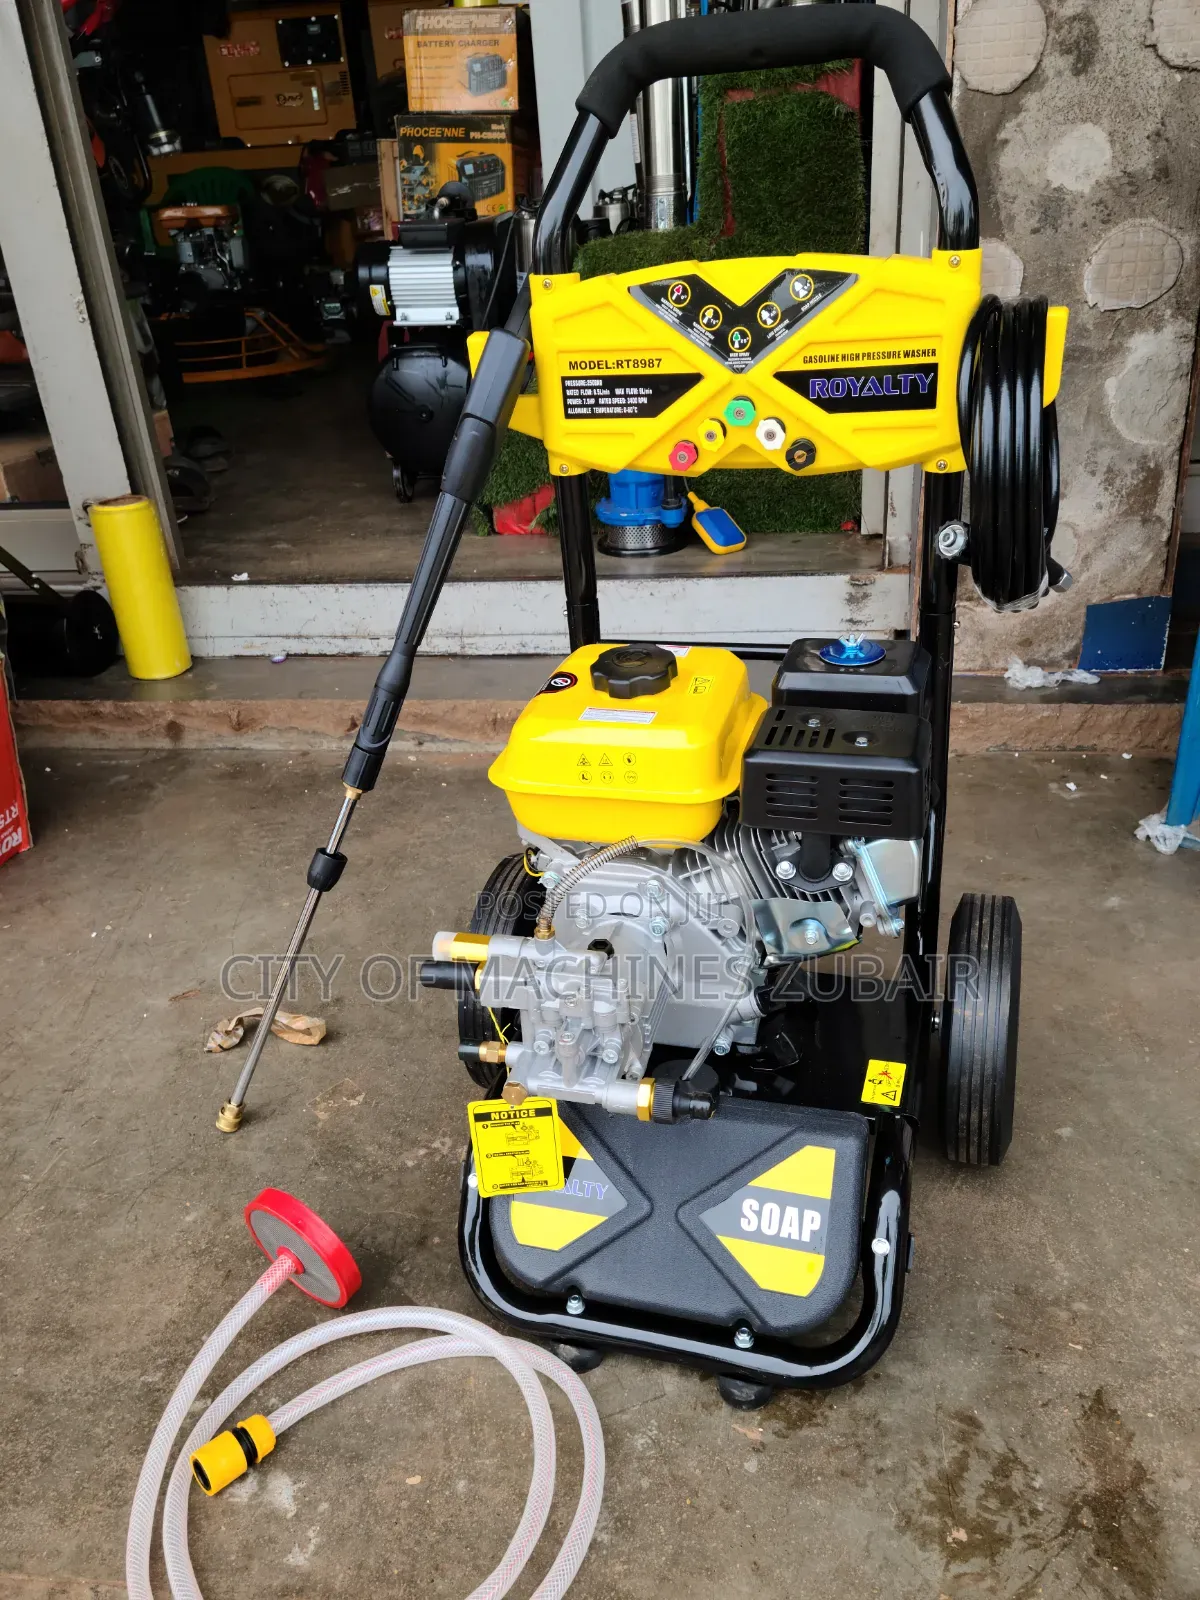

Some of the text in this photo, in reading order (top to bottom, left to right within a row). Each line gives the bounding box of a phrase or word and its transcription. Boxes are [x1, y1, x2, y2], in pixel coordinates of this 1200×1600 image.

[417, 39, 500, 48] BATTERY CHARGER
[399, 127, 466, 137] PHOCEE'NNE
[803, 348, 937, 364] GASOLINE HIGH PRESSURE WASHER
[568, 358, 662, 371] MODEL:RT8987
[809, 372, 935, 399] ROYALTY
[0, 827, 23, 856] RO
[490, 1109, 536, 1121] NOTICE
[740, 1198, 821, 1242] SOAP
